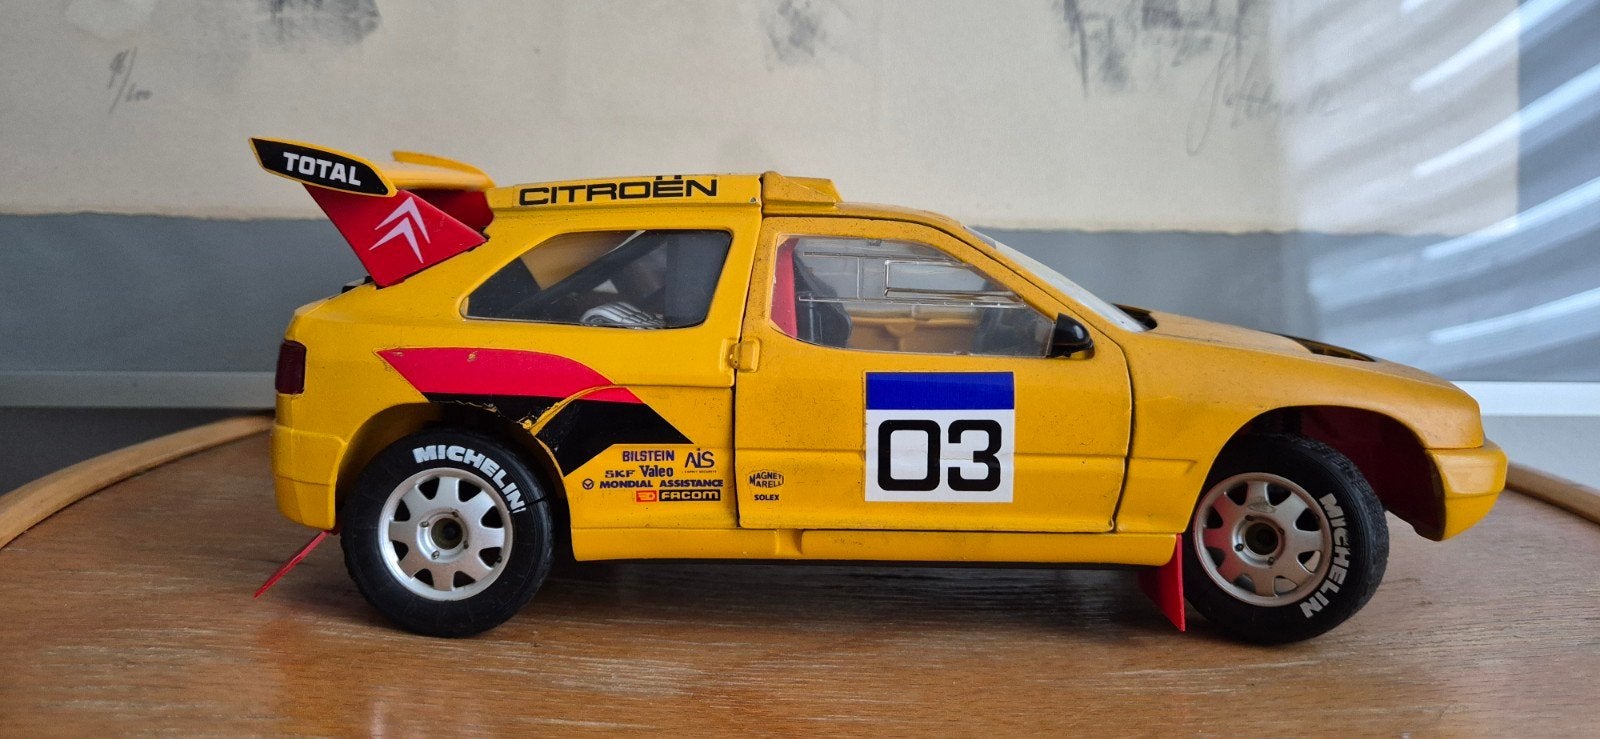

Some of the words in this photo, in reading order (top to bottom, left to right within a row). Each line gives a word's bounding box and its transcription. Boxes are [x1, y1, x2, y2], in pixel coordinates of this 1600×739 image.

[283, 152, 361, 186] TOTAL
[519, 175, 718, 206] CITROËN
[622, 450, 675, 462] BILSTEIN
[878, 420, 1002, 491] 03
[412, 445, 526, 513] MICHELIN
[604, 469, 636, 478] SKF
[639, 465, 674, 478] Valeo
[599, 479, 653, 489] MONDIAL
[659, 479, 724, 488] ASSISTANCE
[661, 491, 719, 500] FACOM
[1300, 493, 1351, 618] MICHELIN
